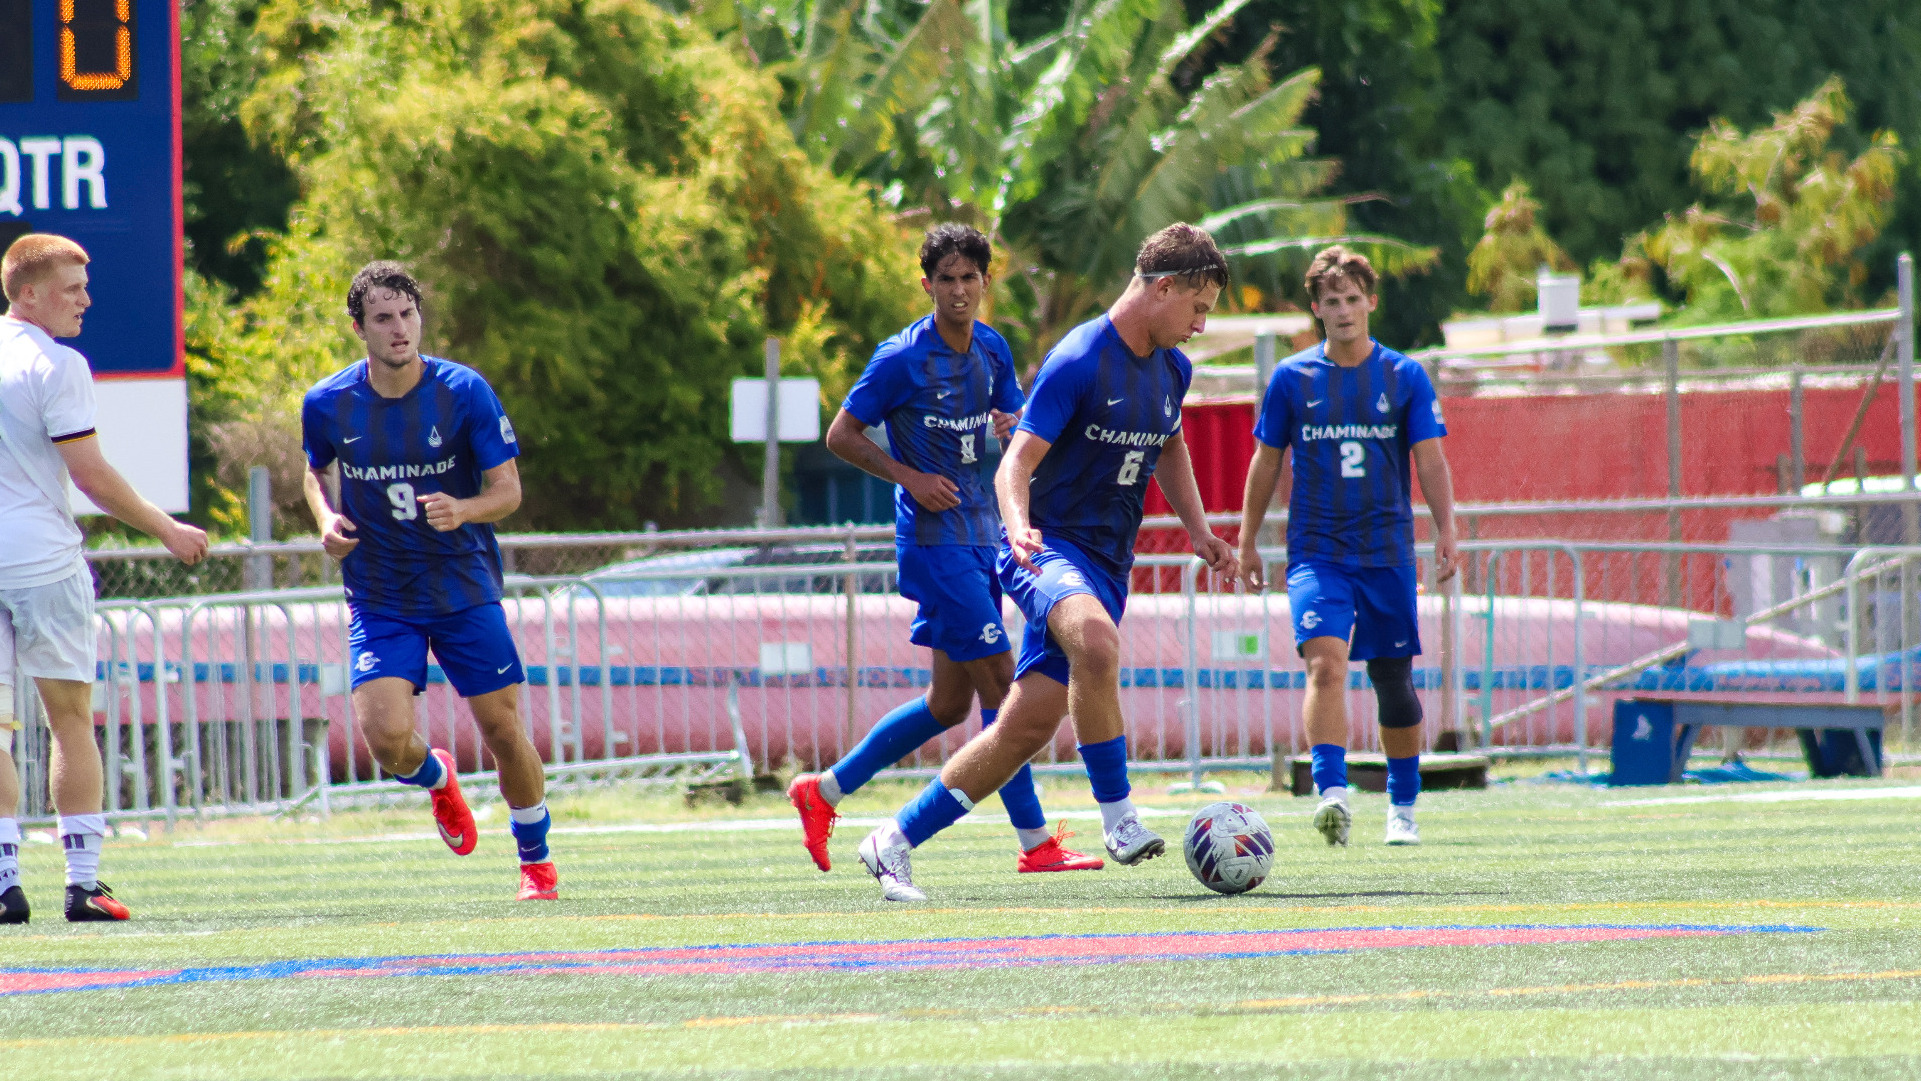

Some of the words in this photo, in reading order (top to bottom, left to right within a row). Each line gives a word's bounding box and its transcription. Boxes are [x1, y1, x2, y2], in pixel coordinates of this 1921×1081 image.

[1085, 423, 1170, 447] CHAMINA
[1302, 424, 1398, 441] CHAMINADE
[342, 454, 457, 481] CHAMINADE
[1117, 450, 1145, 486] 6
[1339, 441, 1367, 478] 2
[386, 482, 418, 521] 9
